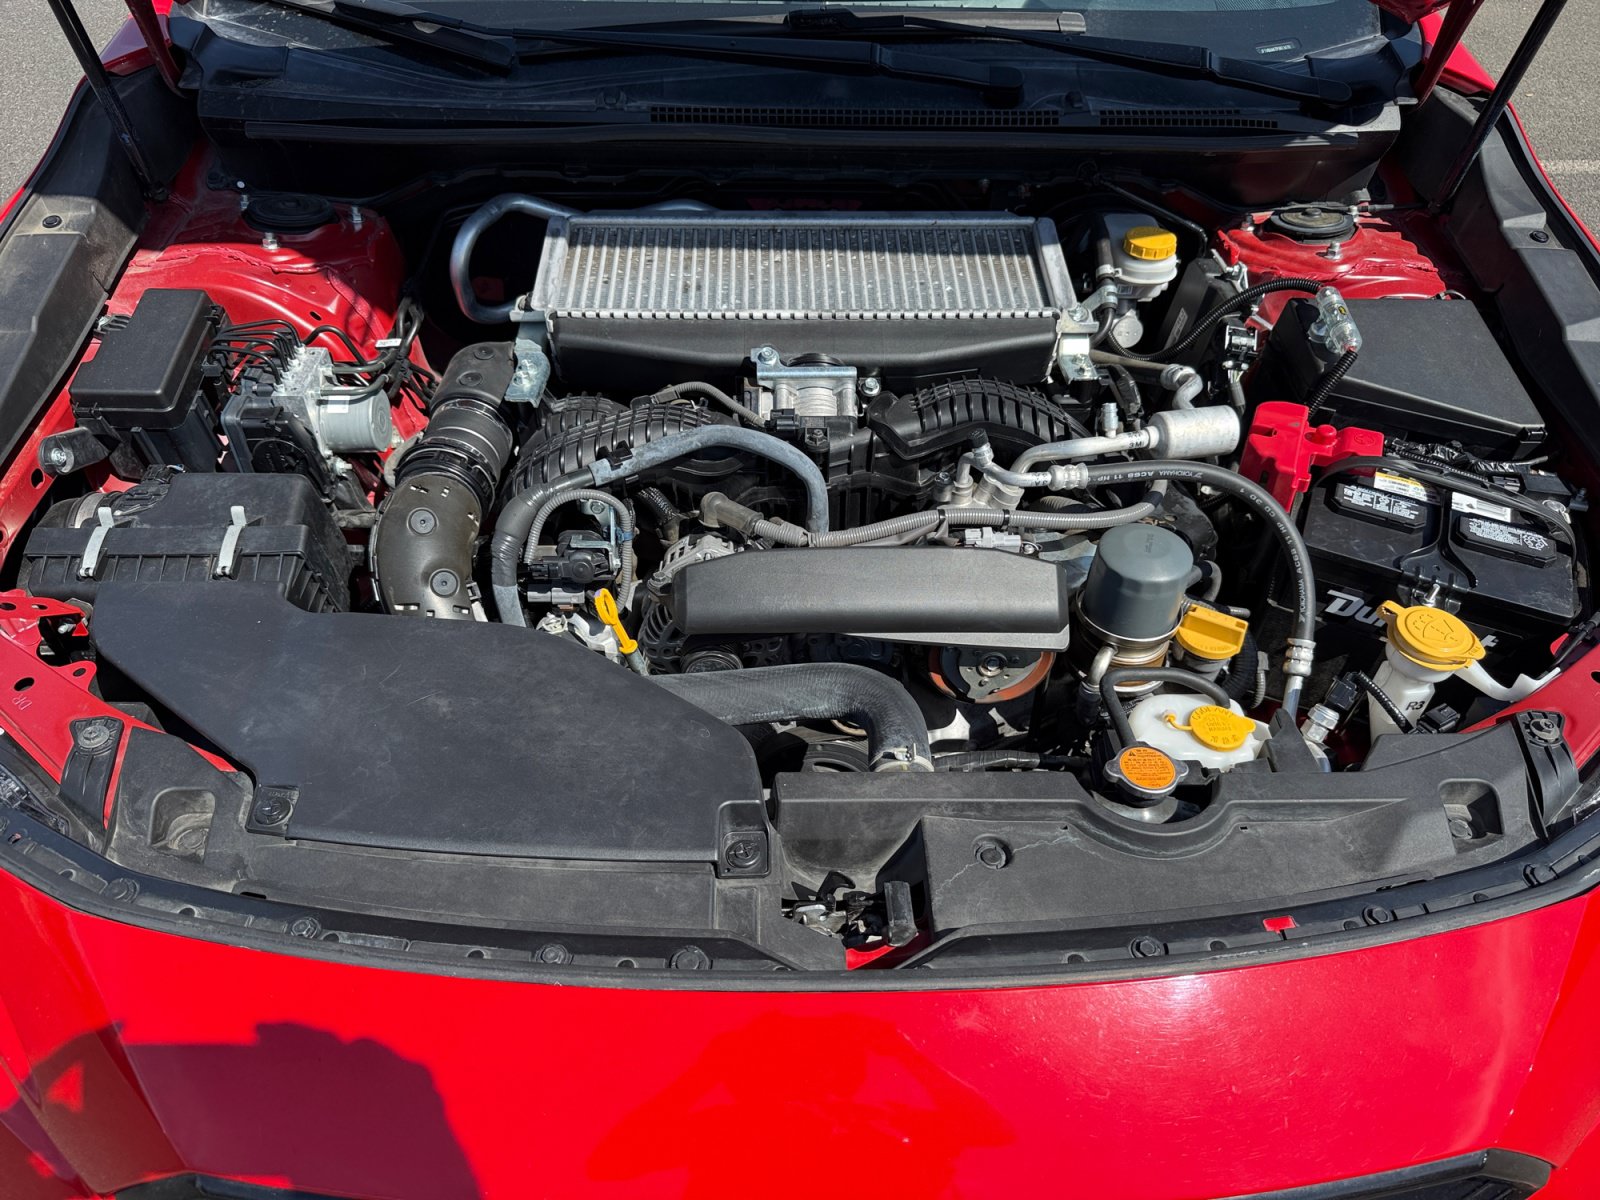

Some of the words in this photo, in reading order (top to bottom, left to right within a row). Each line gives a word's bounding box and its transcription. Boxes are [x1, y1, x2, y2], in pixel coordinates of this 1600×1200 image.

[1097, 474, 1110, 482] HP
[1159, 470, 1193, 478] YOKOHAMA
[1276, 521, 1287, 533] HP
[1285, 535, 1293, 545] 11
[1298, 578, 1306, 613] YOKOHAMA
[1405, 700, 1426, 711] R3
